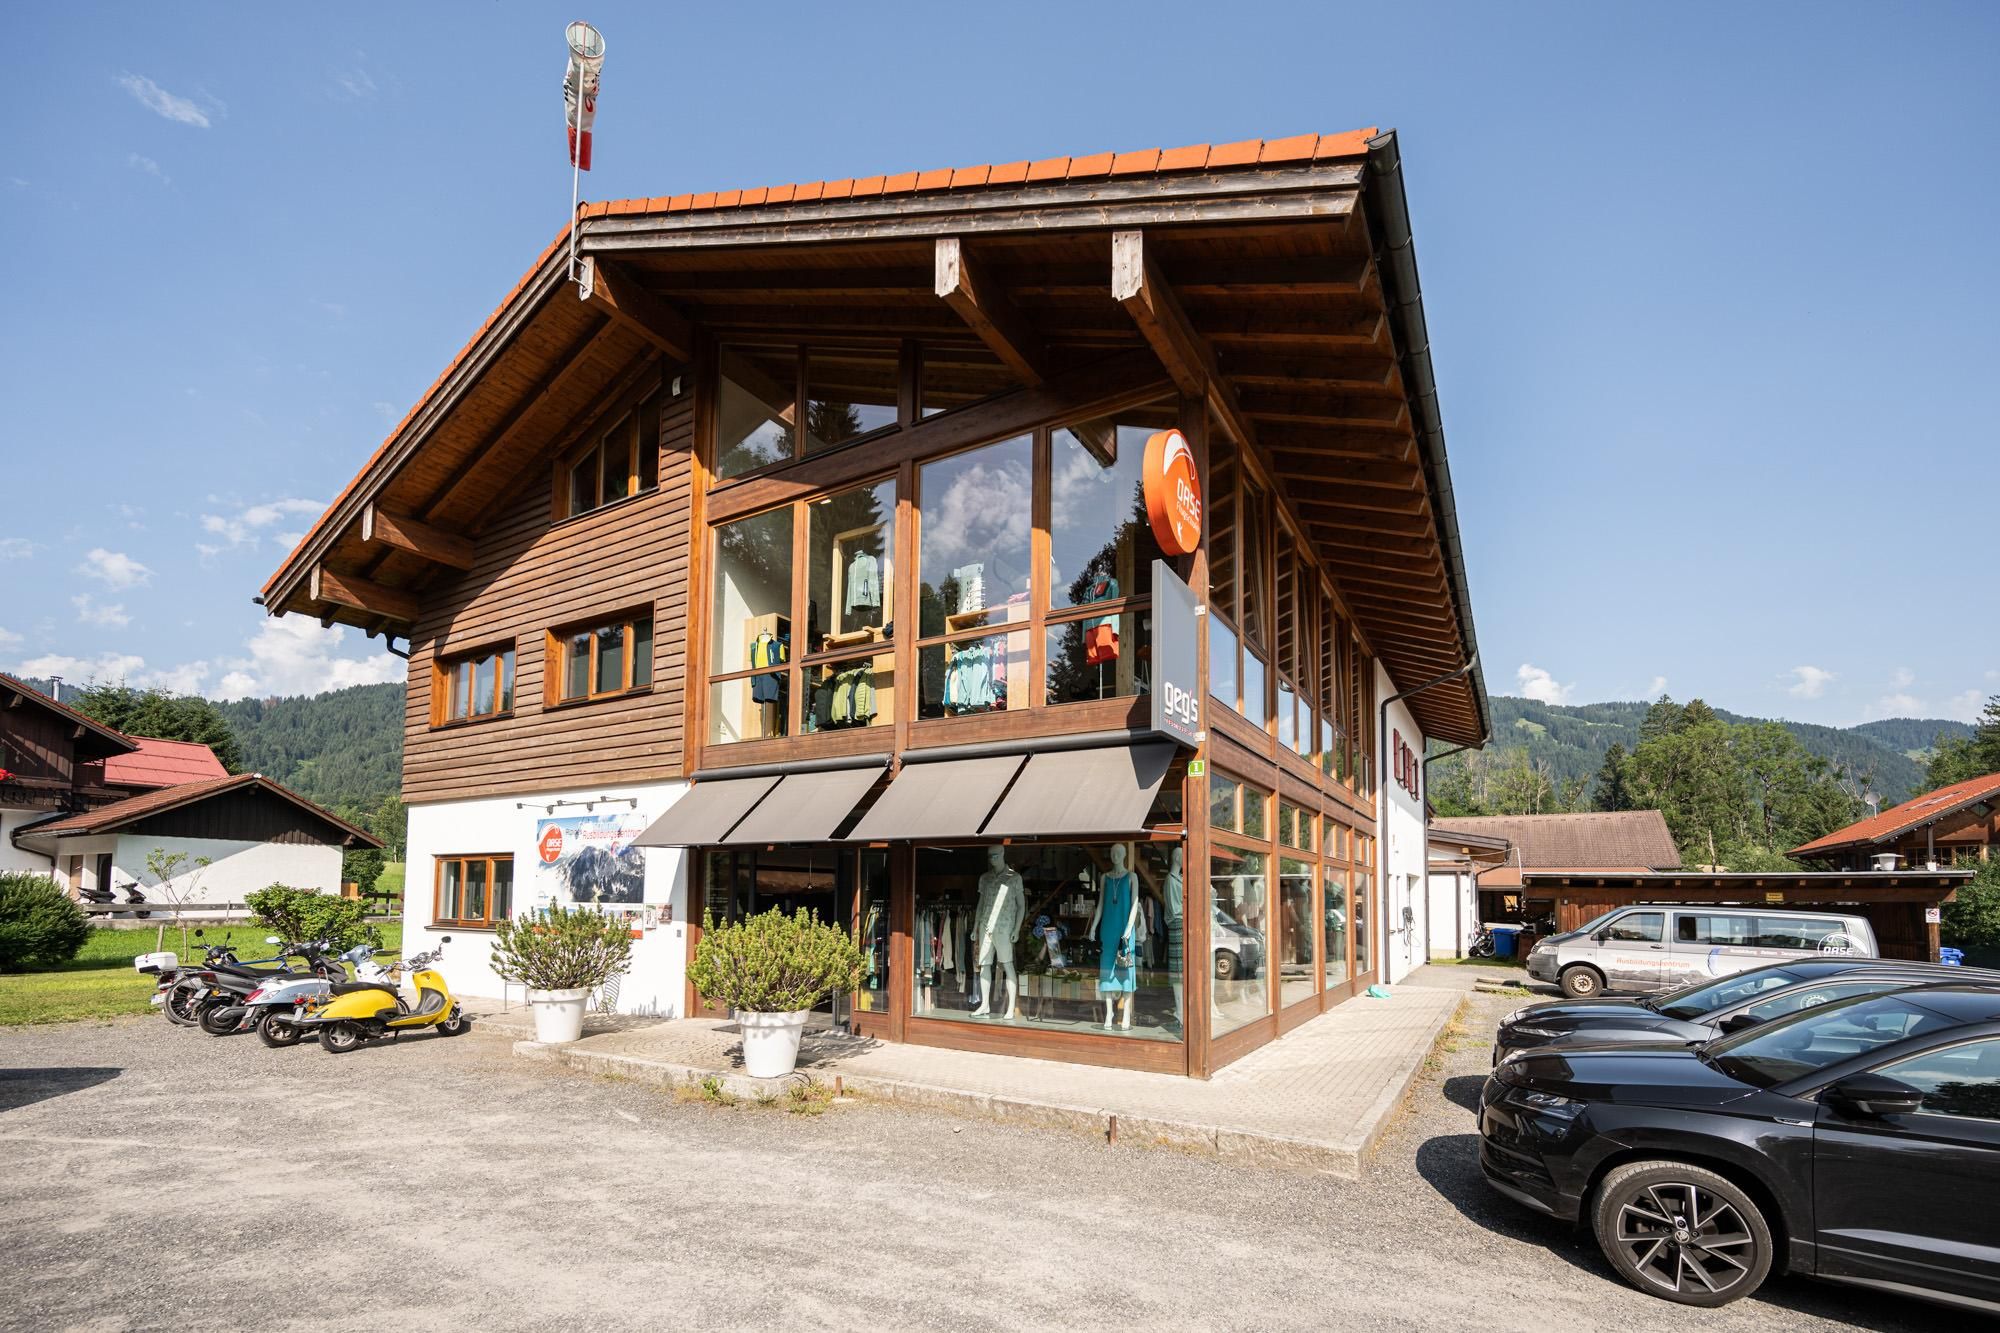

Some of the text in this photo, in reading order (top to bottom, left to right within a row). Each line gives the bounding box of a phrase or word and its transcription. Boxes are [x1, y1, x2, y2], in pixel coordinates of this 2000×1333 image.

[1176, 477, 1201, 521] OASE
[1164, 681, 1198, 724] geg's
[1616, 957, 1690, 969] Ausbildungszentrum
[1823, 946, 1854, 955] OASE
